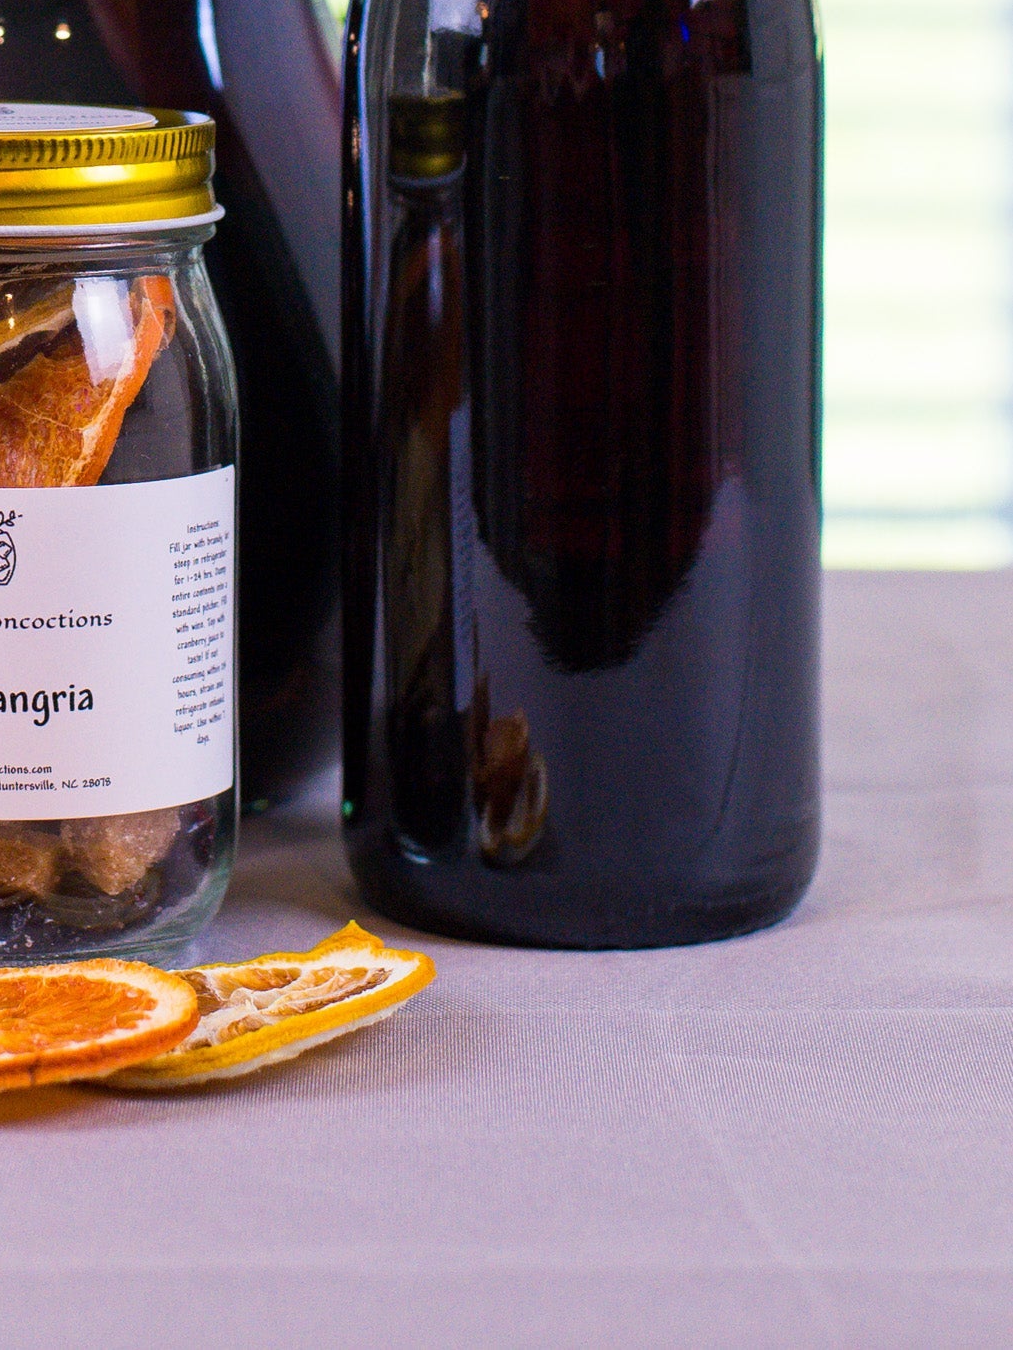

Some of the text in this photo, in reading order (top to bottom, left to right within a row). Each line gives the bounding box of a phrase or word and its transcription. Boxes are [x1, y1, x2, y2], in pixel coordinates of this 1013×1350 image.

[169, 542, 180, 553] Fill
[182, 542, 191, 554] jar
[194, 538, 205, 548] with
[174, 558, 190, 569] steep
[174, 575, 184, 585] for
[187, 571, 201, 581] 1-24
[172, 591, 190, 601] entire
[172, 604, 200, 618] standard
[176, 622, 189, 633] with
[177, 637, 206, 650] cranberry
[172, 670, 205, 684] consuming
[61, 779, 79, 789] NC
[82, 777, 112, 788] 28078
